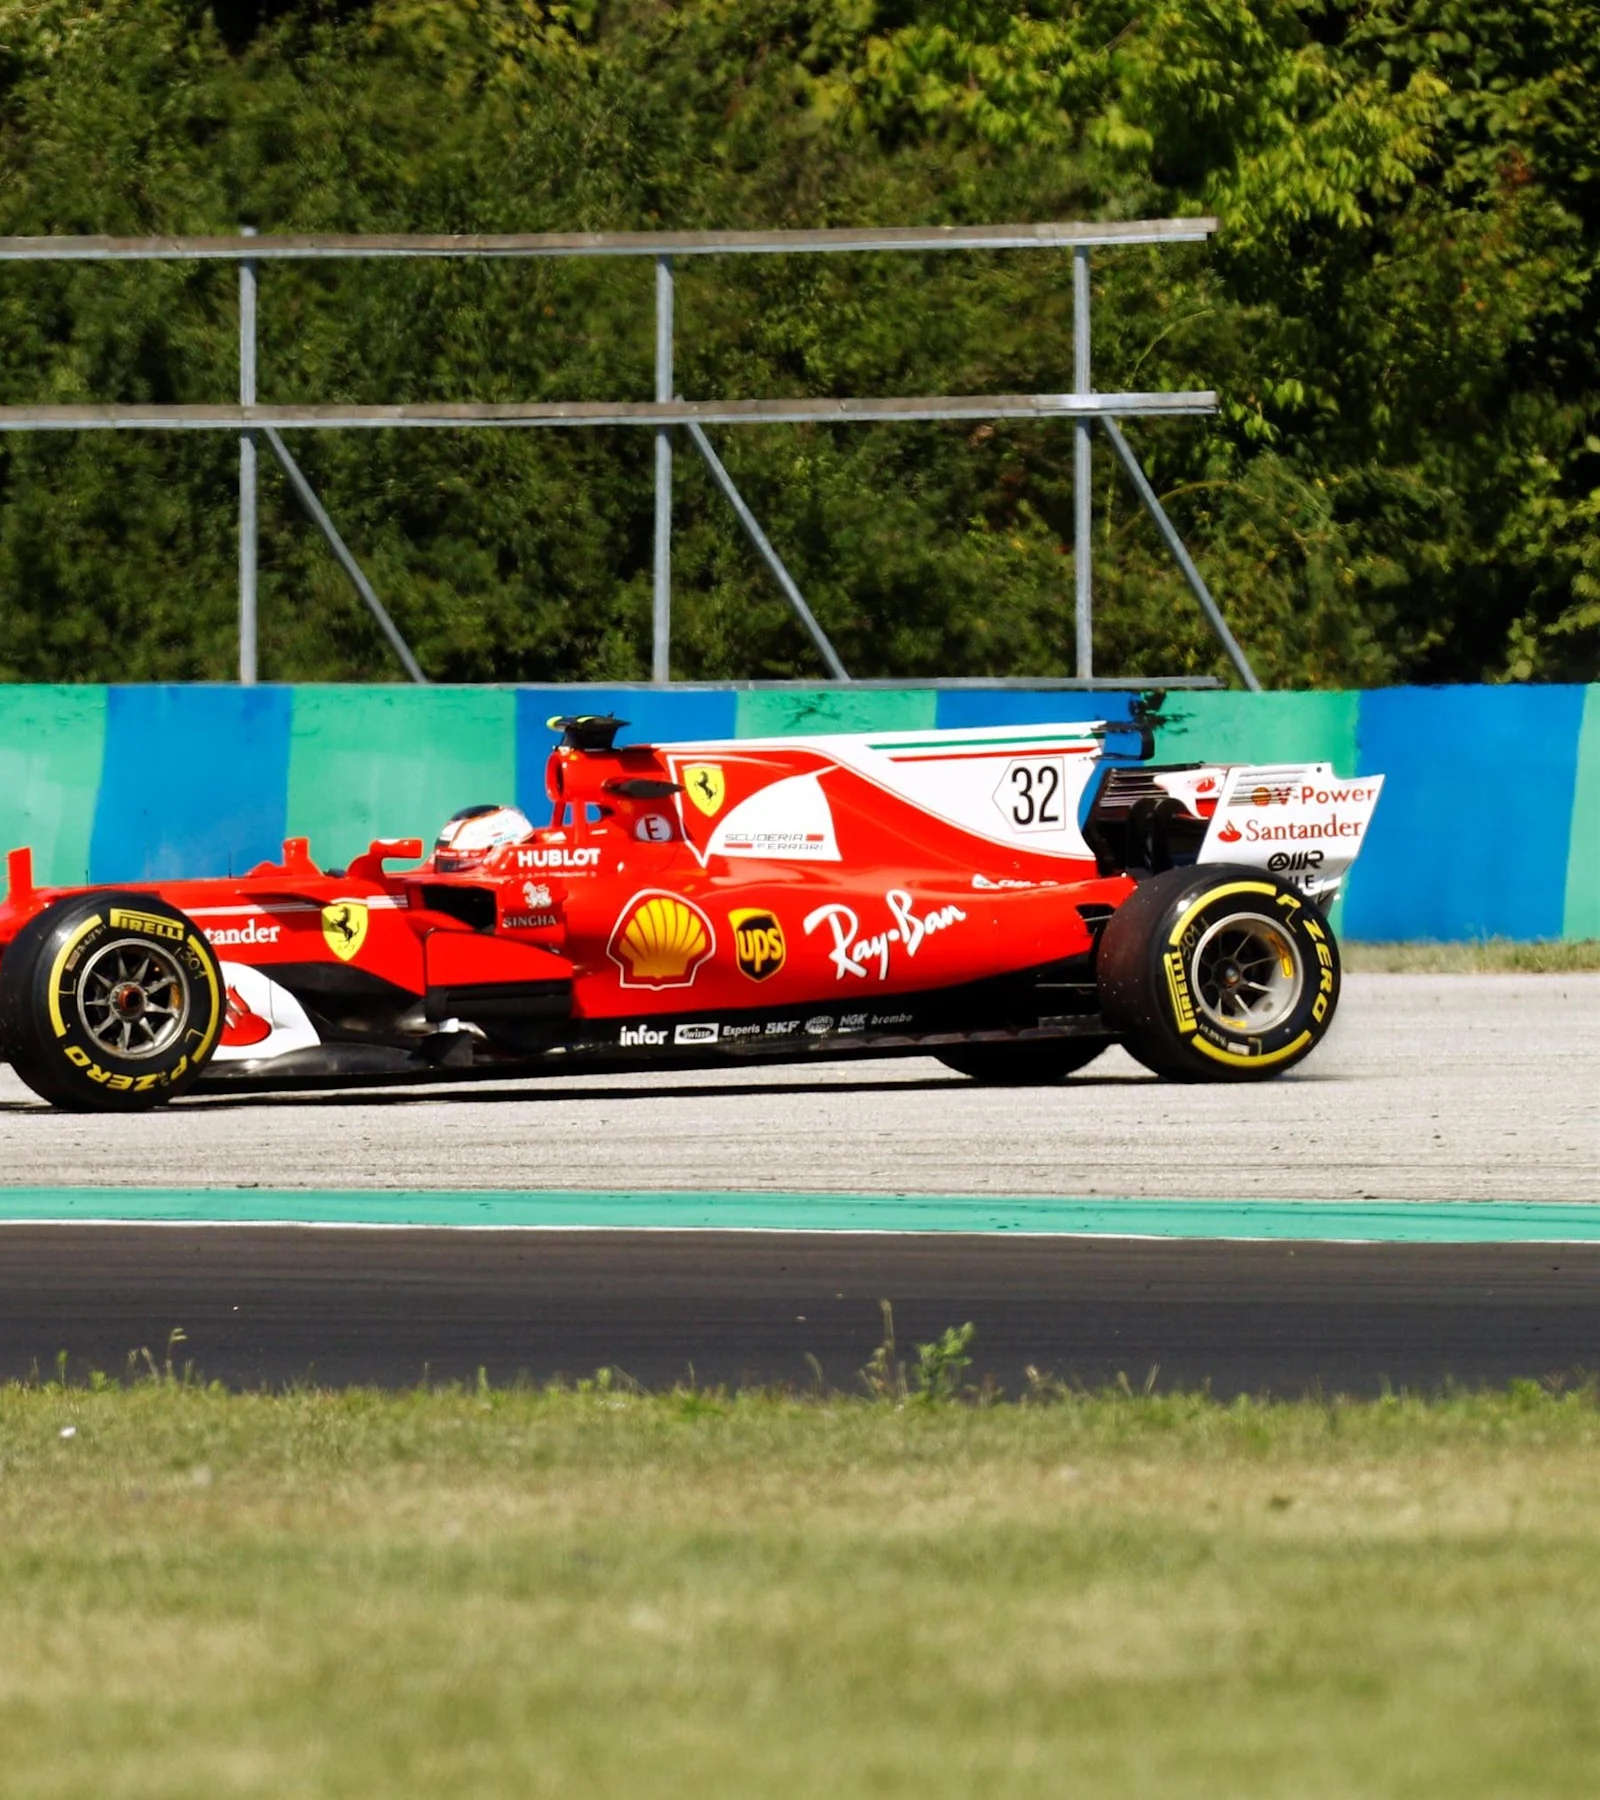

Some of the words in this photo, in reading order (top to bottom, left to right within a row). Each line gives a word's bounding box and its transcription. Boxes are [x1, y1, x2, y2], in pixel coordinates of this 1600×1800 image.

[1011, 765, 1059, 825] 32
[644, 816, 663, 841] E
[725, 833, 803, 842] SCUDERIA
[1246, 813, 1362, 841] Santander
[517, 848, 601, 867] HUBLOT
[757, 843, 823, 851] FERRARI
[110, 908, 185, 941] PIRELLI
[202, 918, 281, 945] tander
[737, 928, 784, 973] ups
[1302, 918, 1333, 1024] ZERO
[1163, 951, 1197, 1033] PIRELLI
[722, 1023, 761, 1038] Experis
[765, 1020, 801, 1035] SKF
[840, 1013, 869, 1027] NGK
[871, 1012, 914, 1025] brembo
[619, 1023, 669, 1047] infor
[681, 1027, 712, 1040] Swisse
[64, 1045, 159, 1092] ZERO
